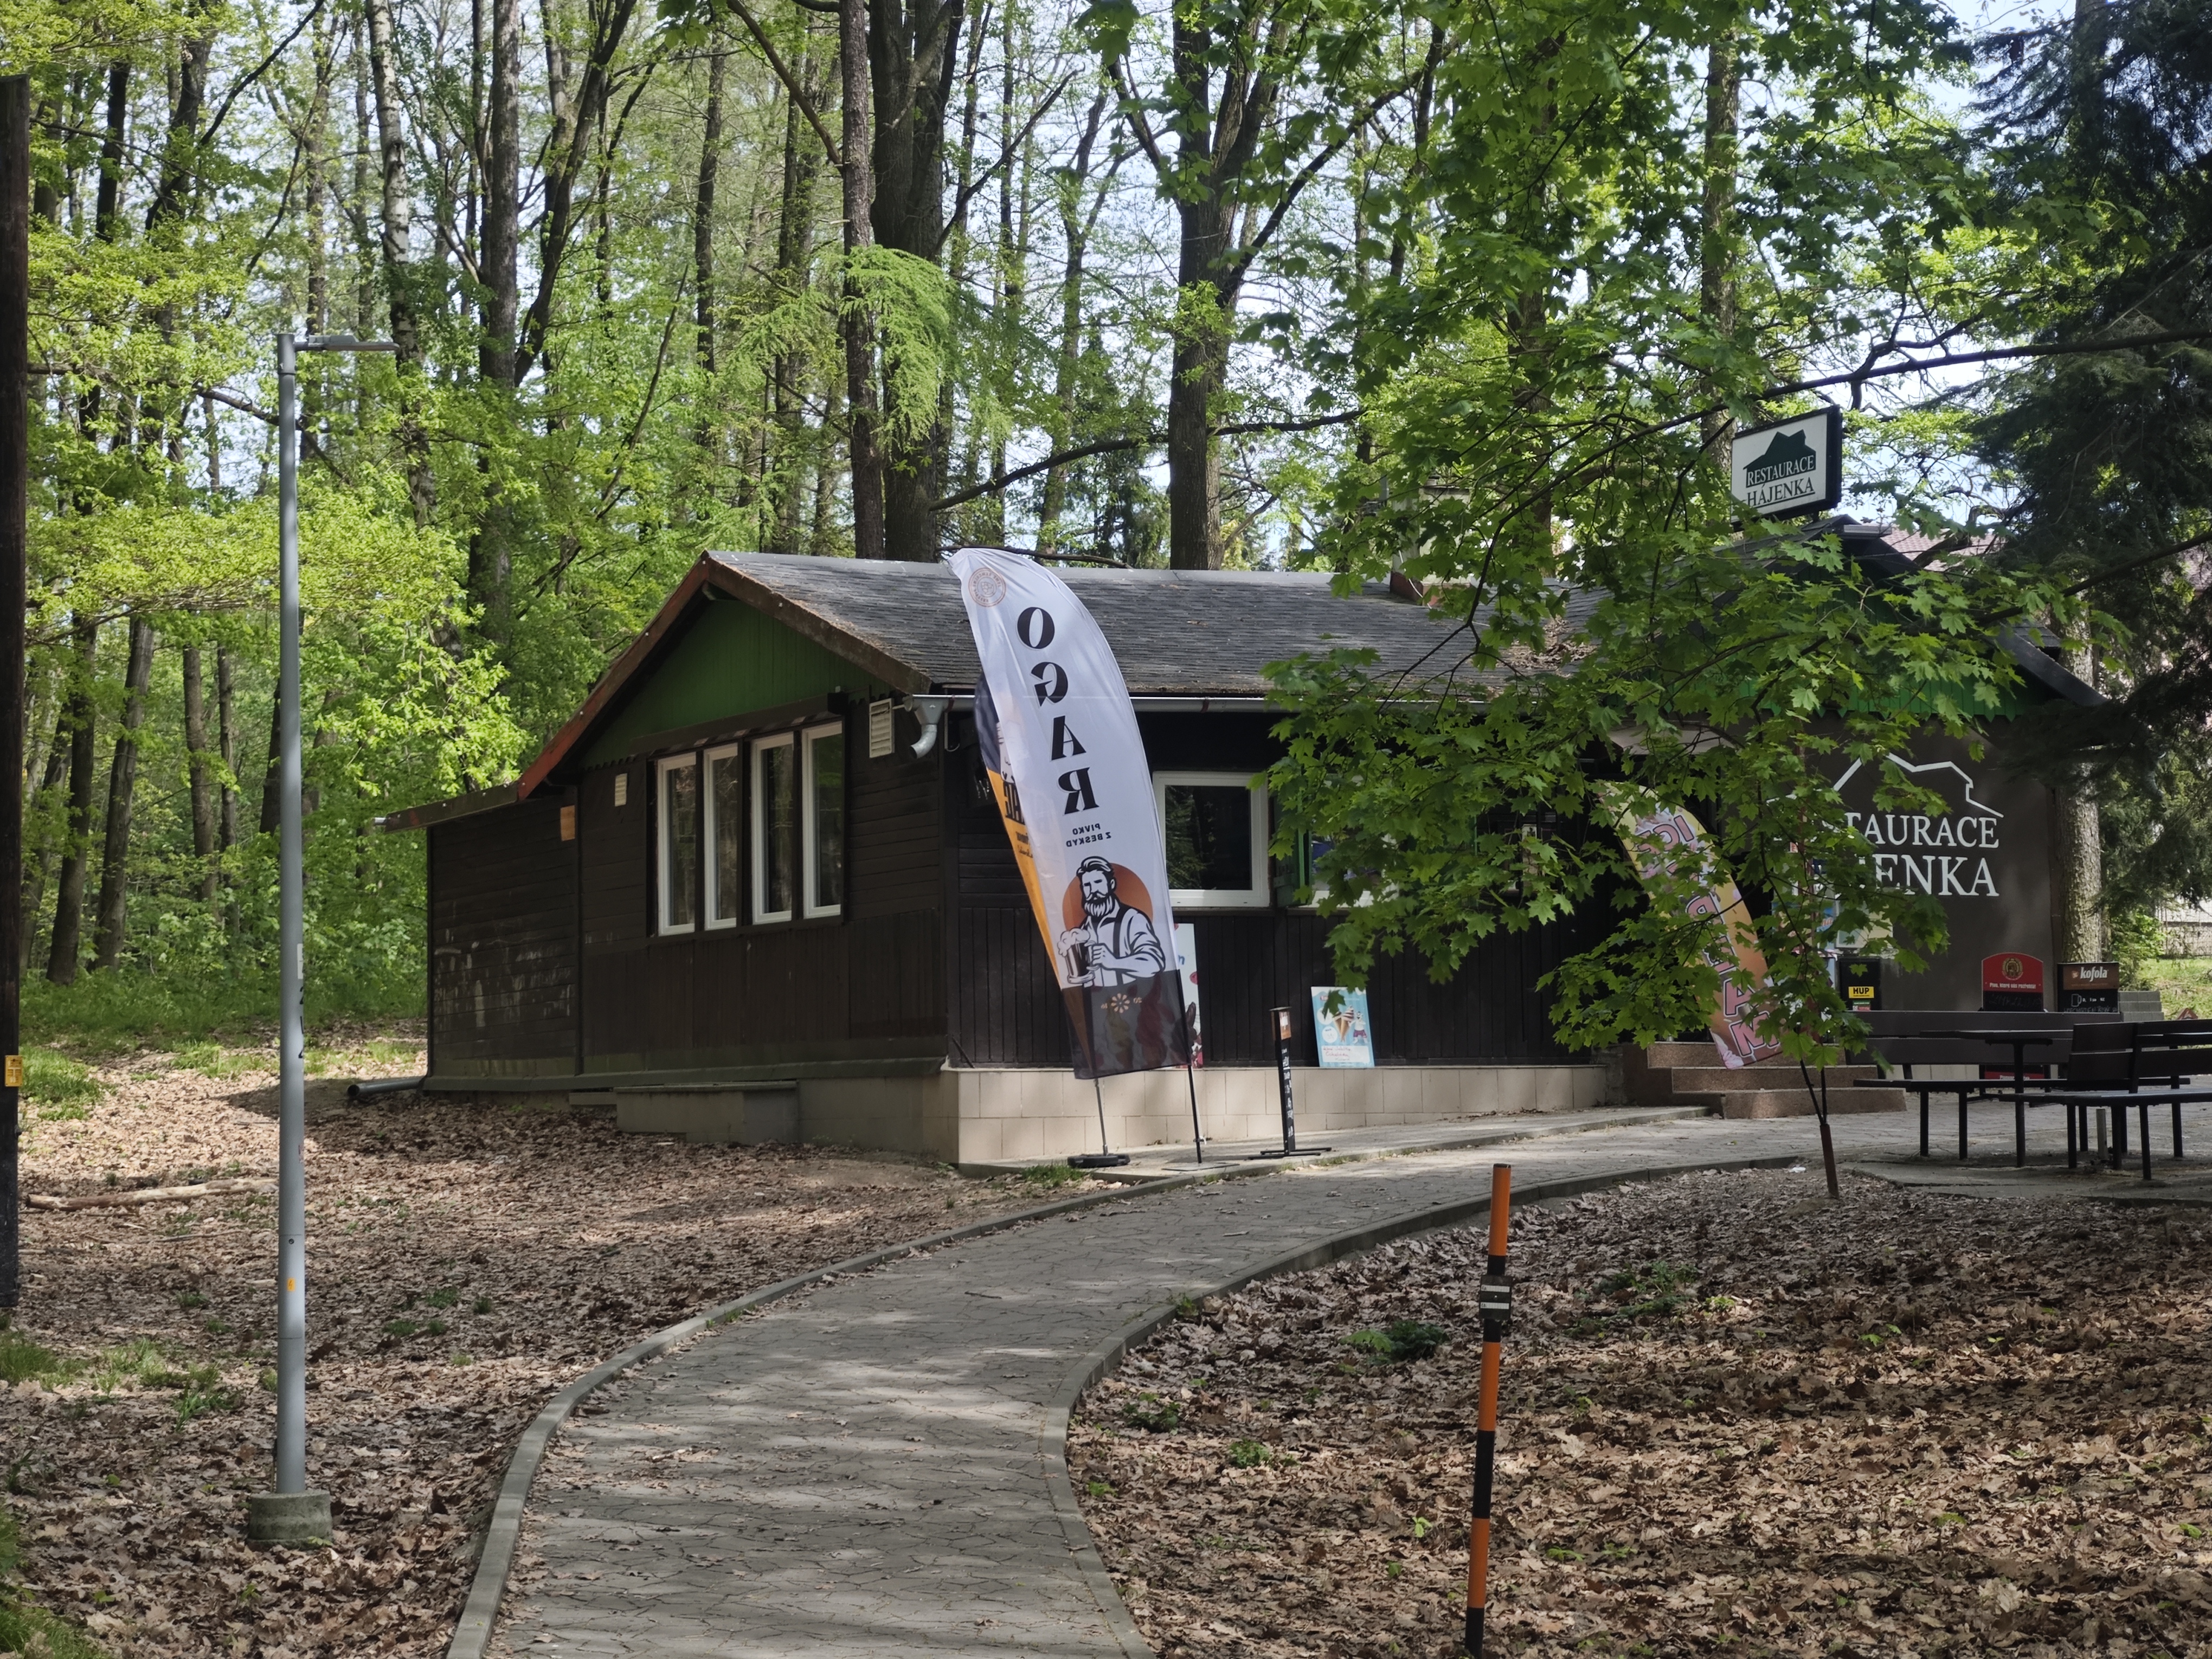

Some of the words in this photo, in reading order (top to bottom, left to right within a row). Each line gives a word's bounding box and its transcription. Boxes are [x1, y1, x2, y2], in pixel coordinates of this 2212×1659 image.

[1748, 455, 1814, 486] RESTAURACE
[1747, 477, 1814, 506] HÁJENKA
[2080, 966, 2108, 982] kofola
